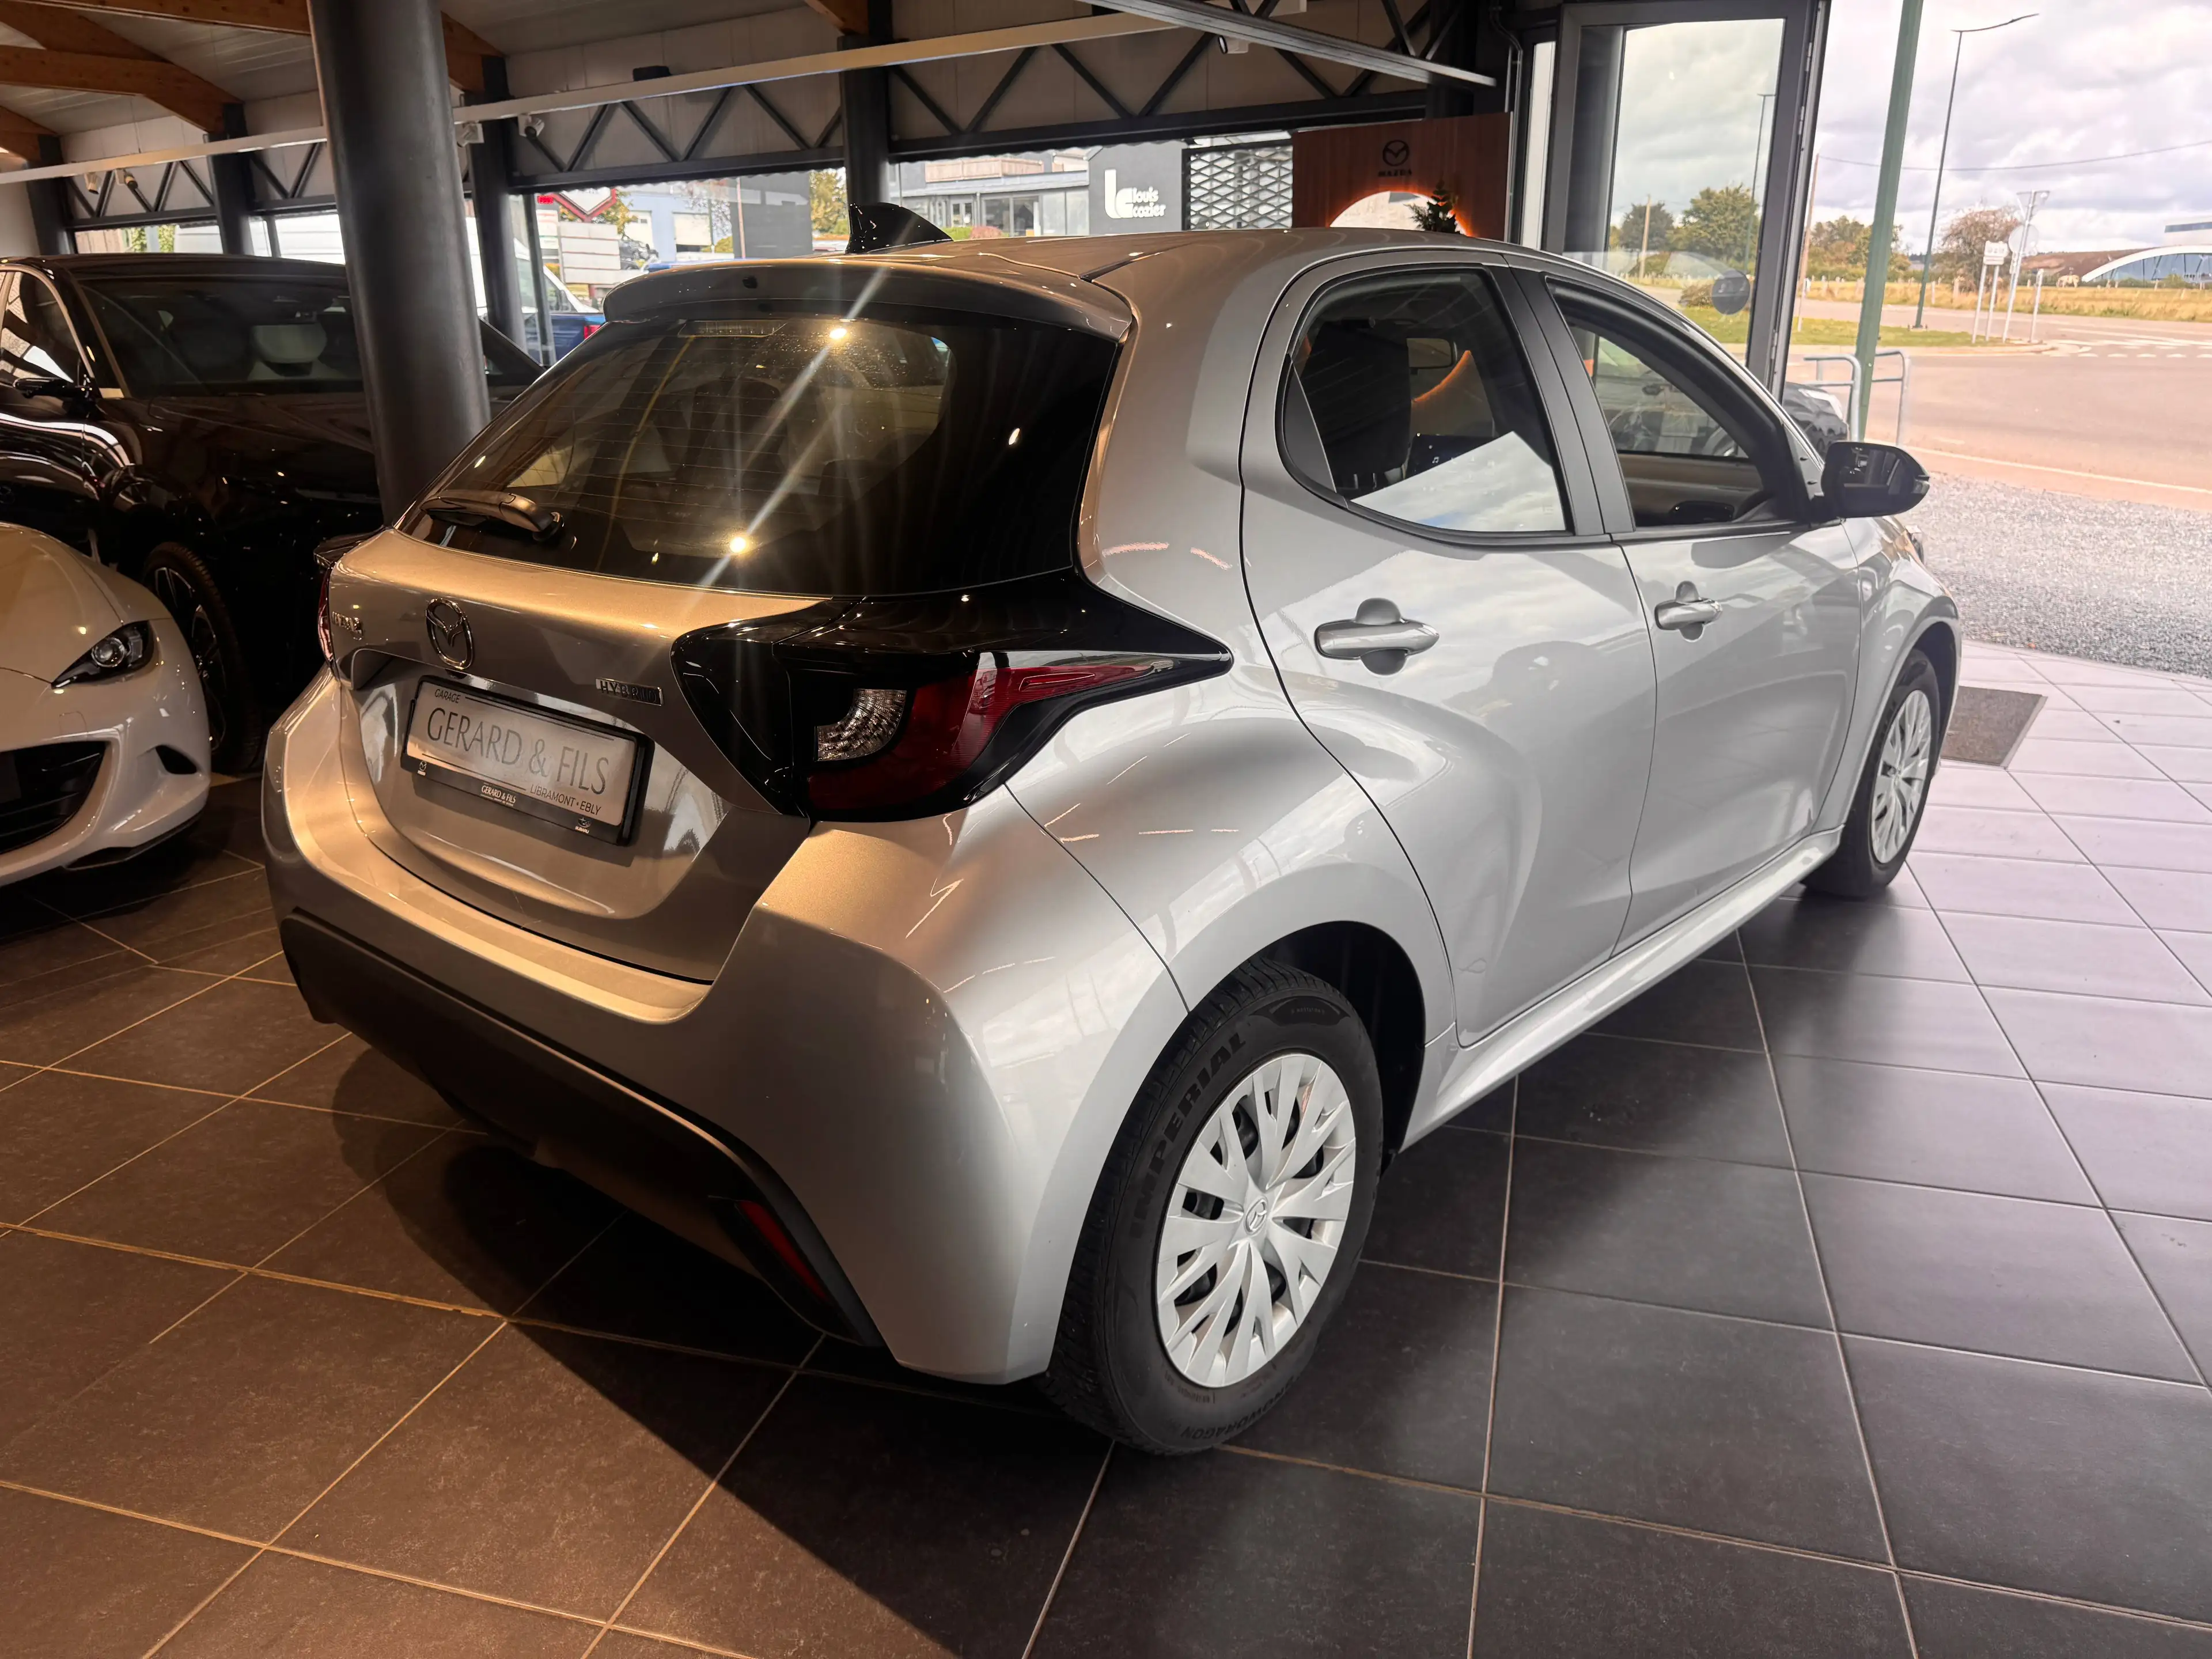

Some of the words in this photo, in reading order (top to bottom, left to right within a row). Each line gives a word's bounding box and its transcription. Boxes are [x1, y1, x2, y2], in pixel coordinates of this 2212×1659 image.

[1132, 186, 1159, 203] louis
[434, 688, 461, 703] GARAGE
[600, 680, 657, 703] HYBRID
[427, 707, 522, 766] GERARD
[529, 738, 548, 778] &
[556, 745, 609, 795] FILS
[481, 785, 501, 798] GERARD
[506, 794, 517, 804] FILS
[530, 784, 577, 808] LIBRAMONT
[579, 800, 602, 816] EBLY
[1128, 1032, 1247, 1239] IMPERIAL
